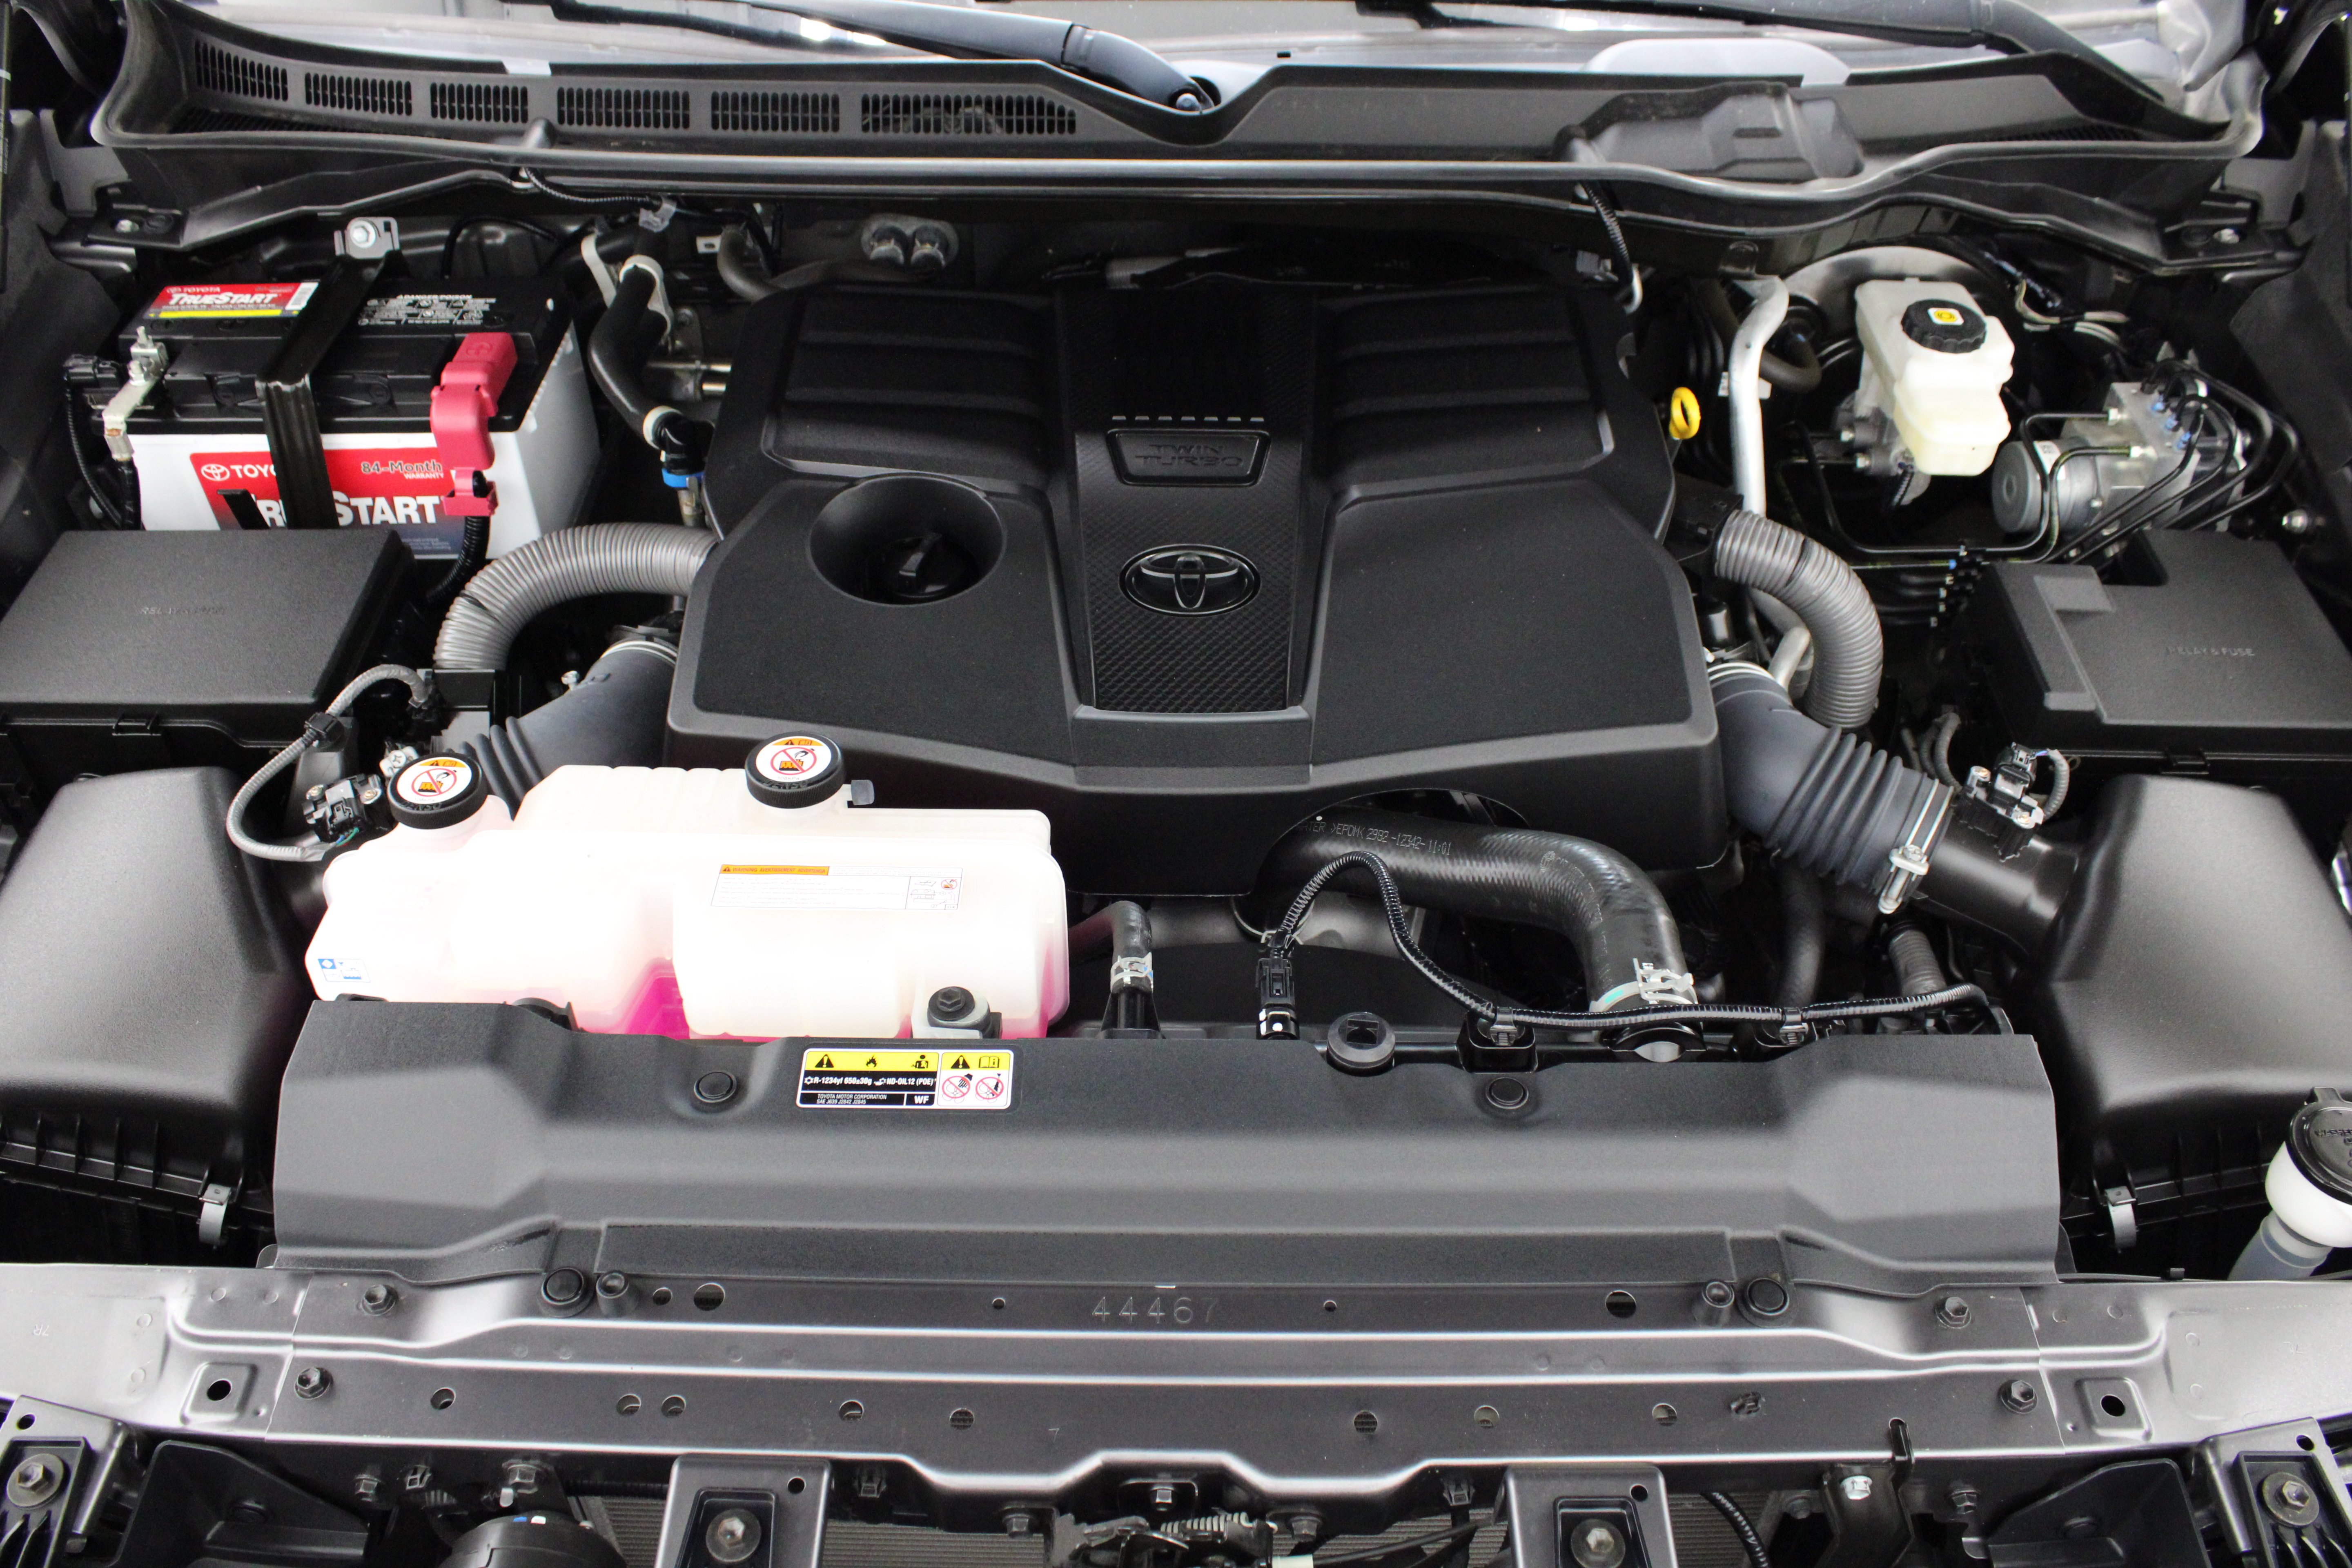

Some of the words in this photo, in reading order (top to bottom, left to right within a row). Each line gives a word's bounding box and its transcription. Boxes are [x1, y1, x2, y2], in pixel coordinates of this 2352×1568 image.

[1149, 444, 1224, 454] TWIN
[1135, 455, 1243, 466] TURBO
[230, 464, 277, 478] TOY
[361, 459, 442, 474] 84-Month
[813, 1076, 843, 1085] R-1234yf
[844, 1077, 872, 1086] 650±30g
[914, 1096, 929, 1104] WF
